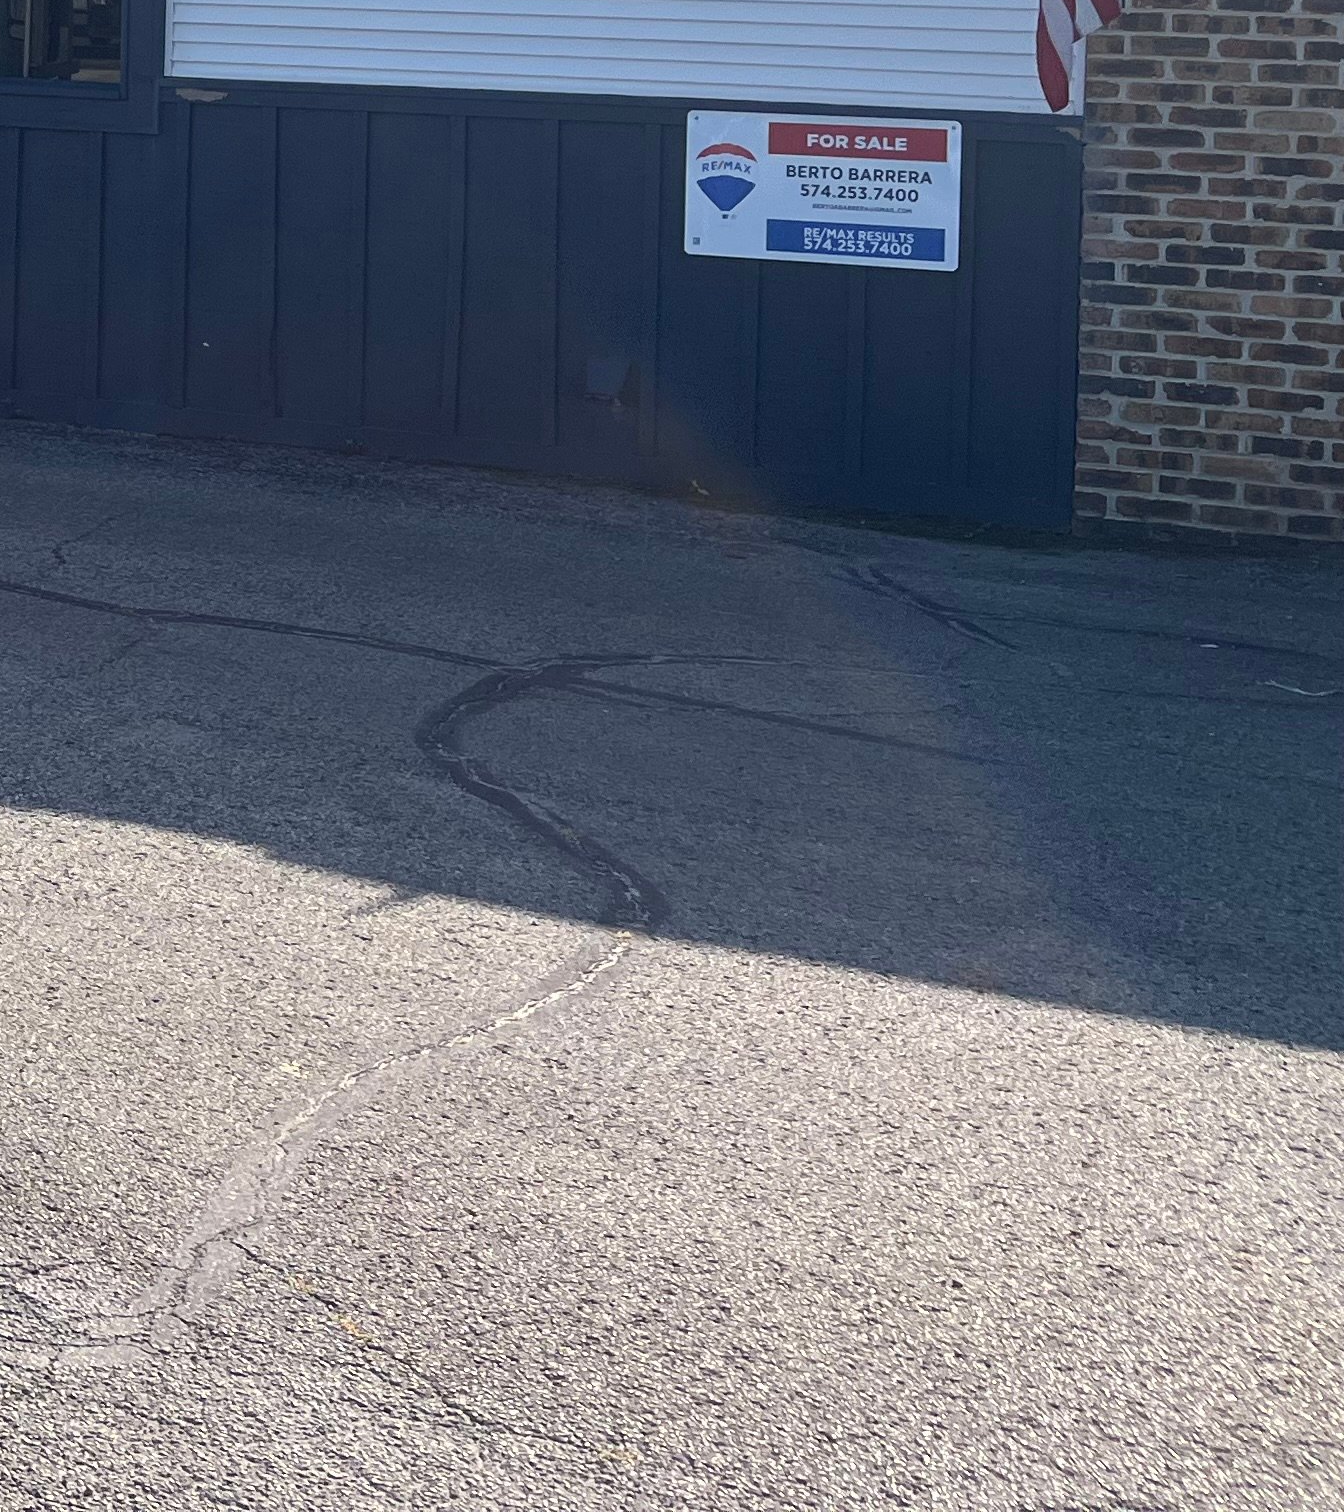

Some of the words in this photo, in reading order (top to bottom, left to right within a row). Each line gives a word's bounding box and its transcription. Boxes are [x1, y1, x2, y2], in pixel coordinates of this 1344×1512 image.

[806, 133, 849, 149] FOR
[854, 135, 908, 152] SALE
[701, 160, 752, 174] RE/MAX
[786, 164, 844, 181] BERTO
[848, 167, 933, 185] BARRERA
[800, 183, 919, 203] 574.253.7400
[803, 227, 855, 241] RE/MAX
[858, 230, 915, 244] RESULTS
[803, 238, 913, 256] 574.253.7400
